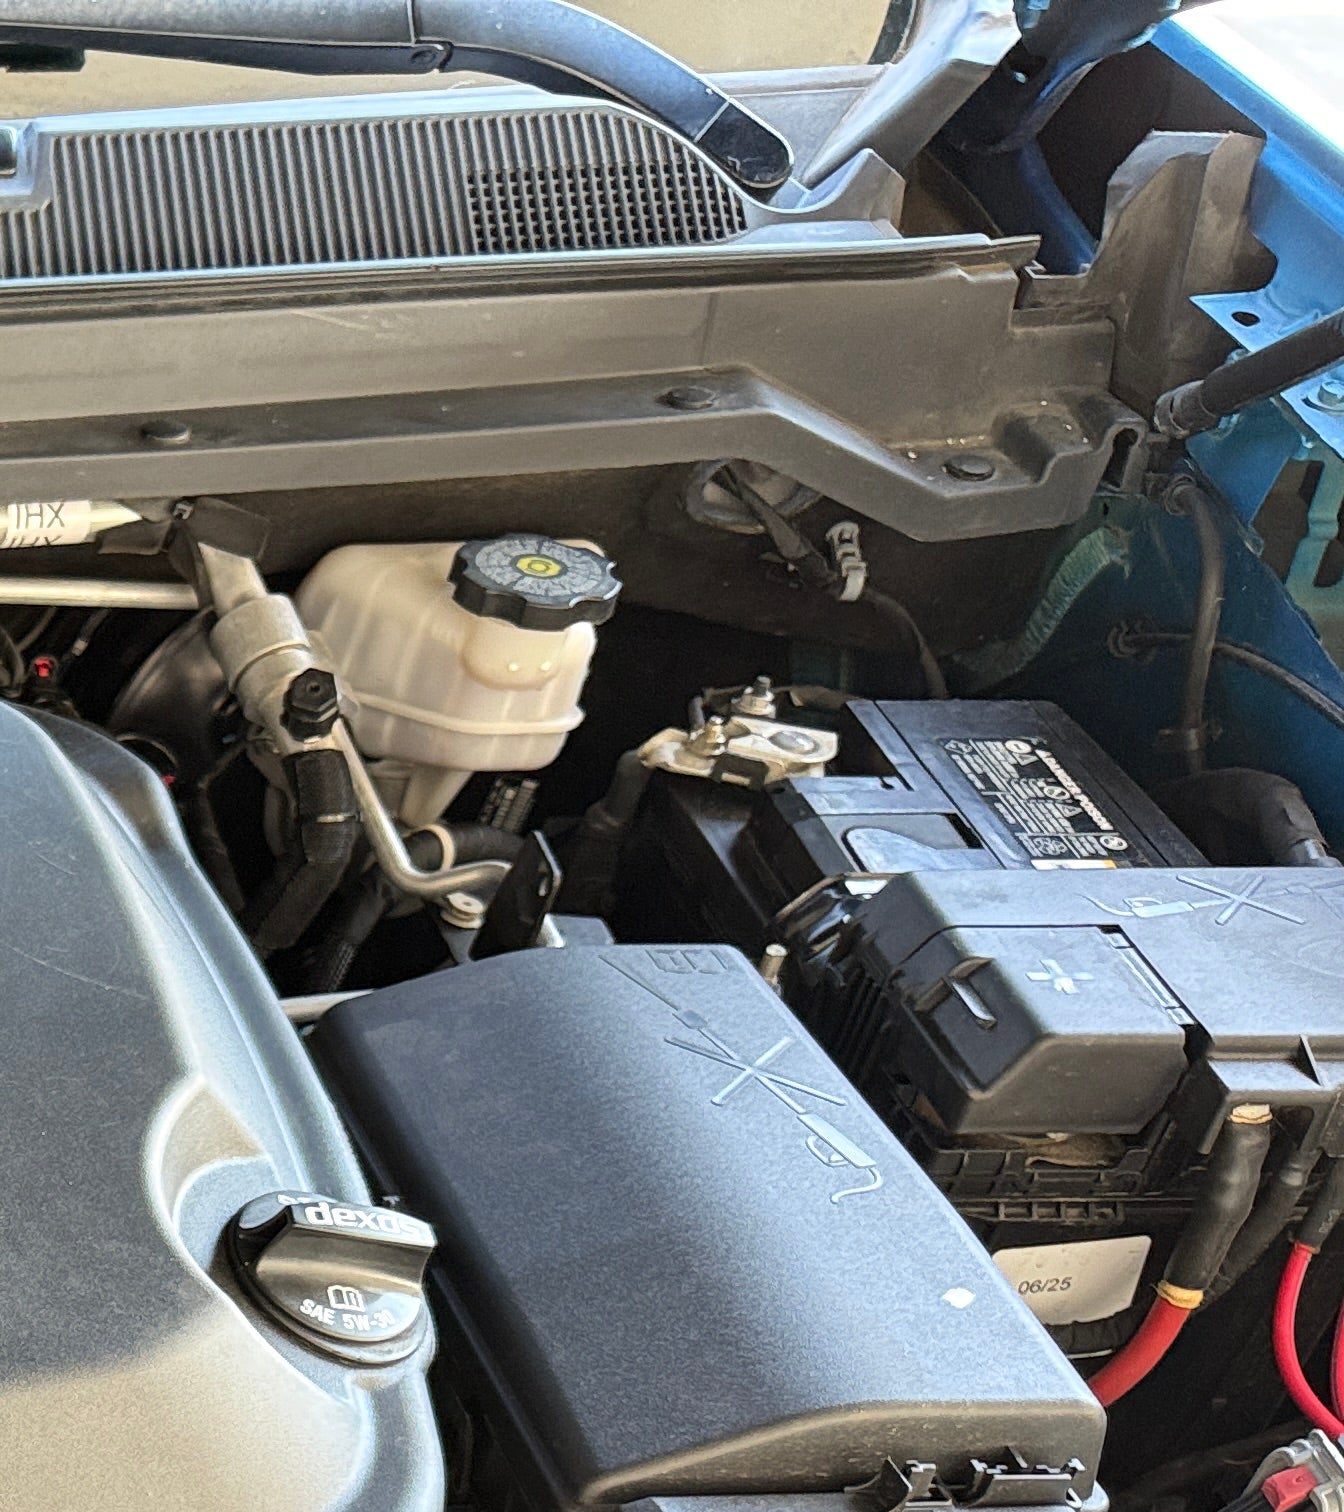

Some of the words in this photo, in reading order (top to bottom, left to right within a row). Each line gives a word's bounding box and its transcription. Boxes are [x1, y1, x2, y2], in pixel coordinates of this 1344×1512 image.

[1018, 1276, 1073, 1296] 06/25
[299, 1298, 336, 1327] SAE
[342, 1308, 396, 1332] 5W-30
